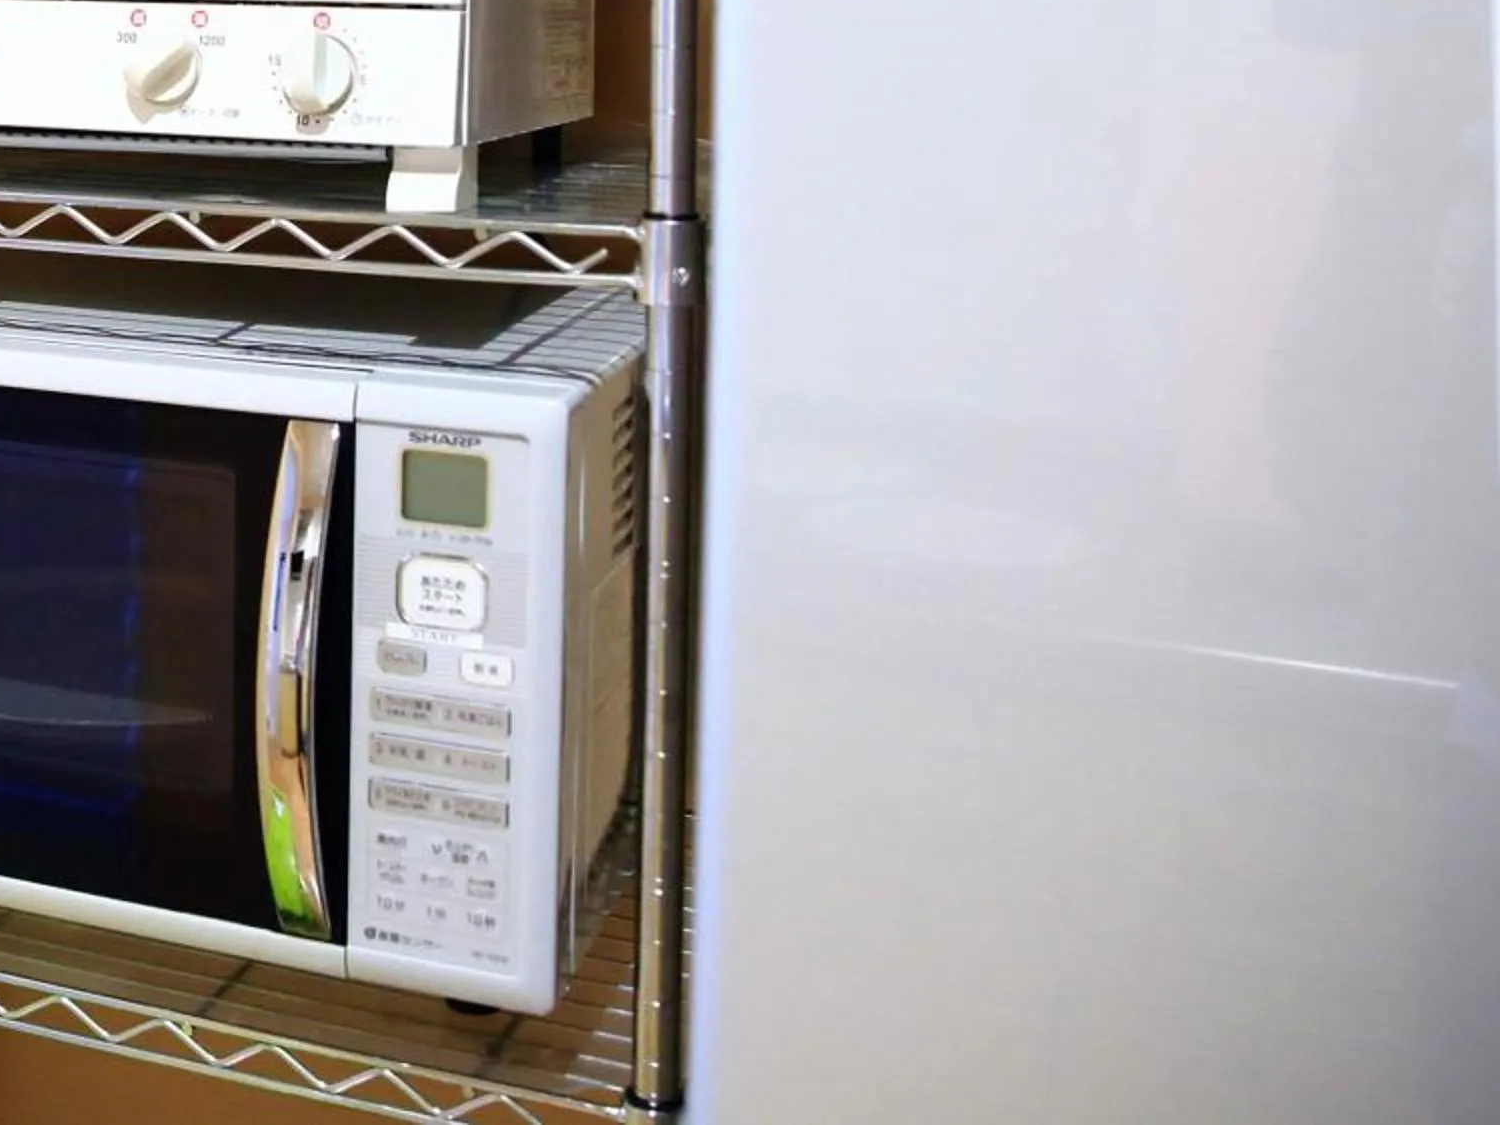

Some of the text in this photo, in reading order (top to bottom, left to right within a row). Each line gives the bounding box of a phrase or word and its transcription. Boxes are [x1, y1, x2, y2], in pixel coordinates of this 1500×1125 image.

[199, 35, 225, 47] 1200
[296, 115, 309, 126] 10
[408, 431, 482, 448] SHARP
